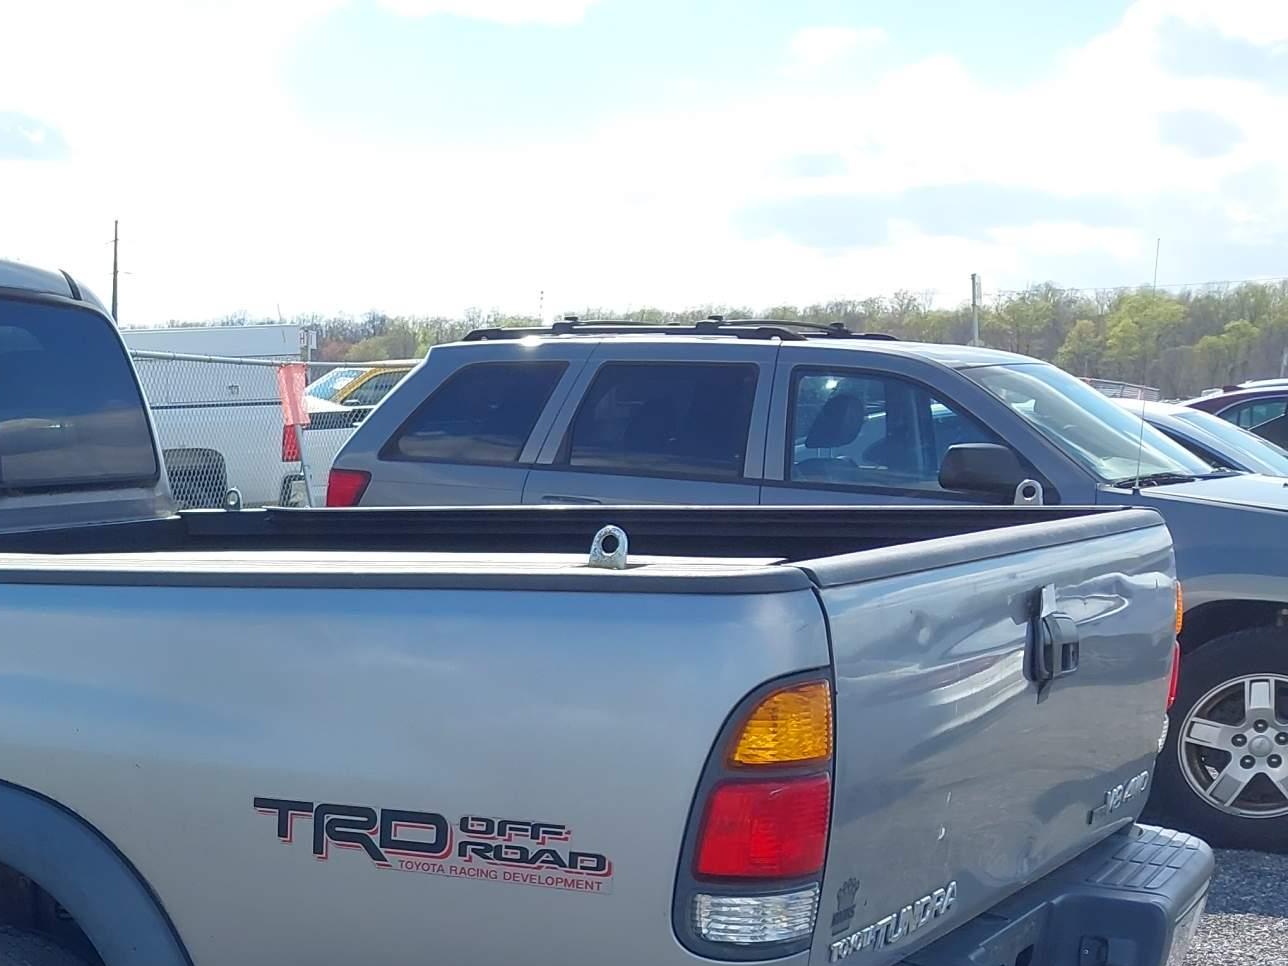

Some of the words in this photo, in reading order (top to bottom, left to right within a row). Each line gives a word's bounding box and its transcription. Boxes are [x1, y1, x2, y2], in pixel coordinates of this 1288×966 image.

[254, 797, 453, 877] TRD
[459, 816, 571, 845] OFF
[457, 840, 613, 877] ROAD
[398, 859, 445, 874] TOYOTA
[449, 866, 498, 880] RACING
[503, 871, 603, 891] DEVELOPMENT
[872, 881, 957, 952] TUNDRA
